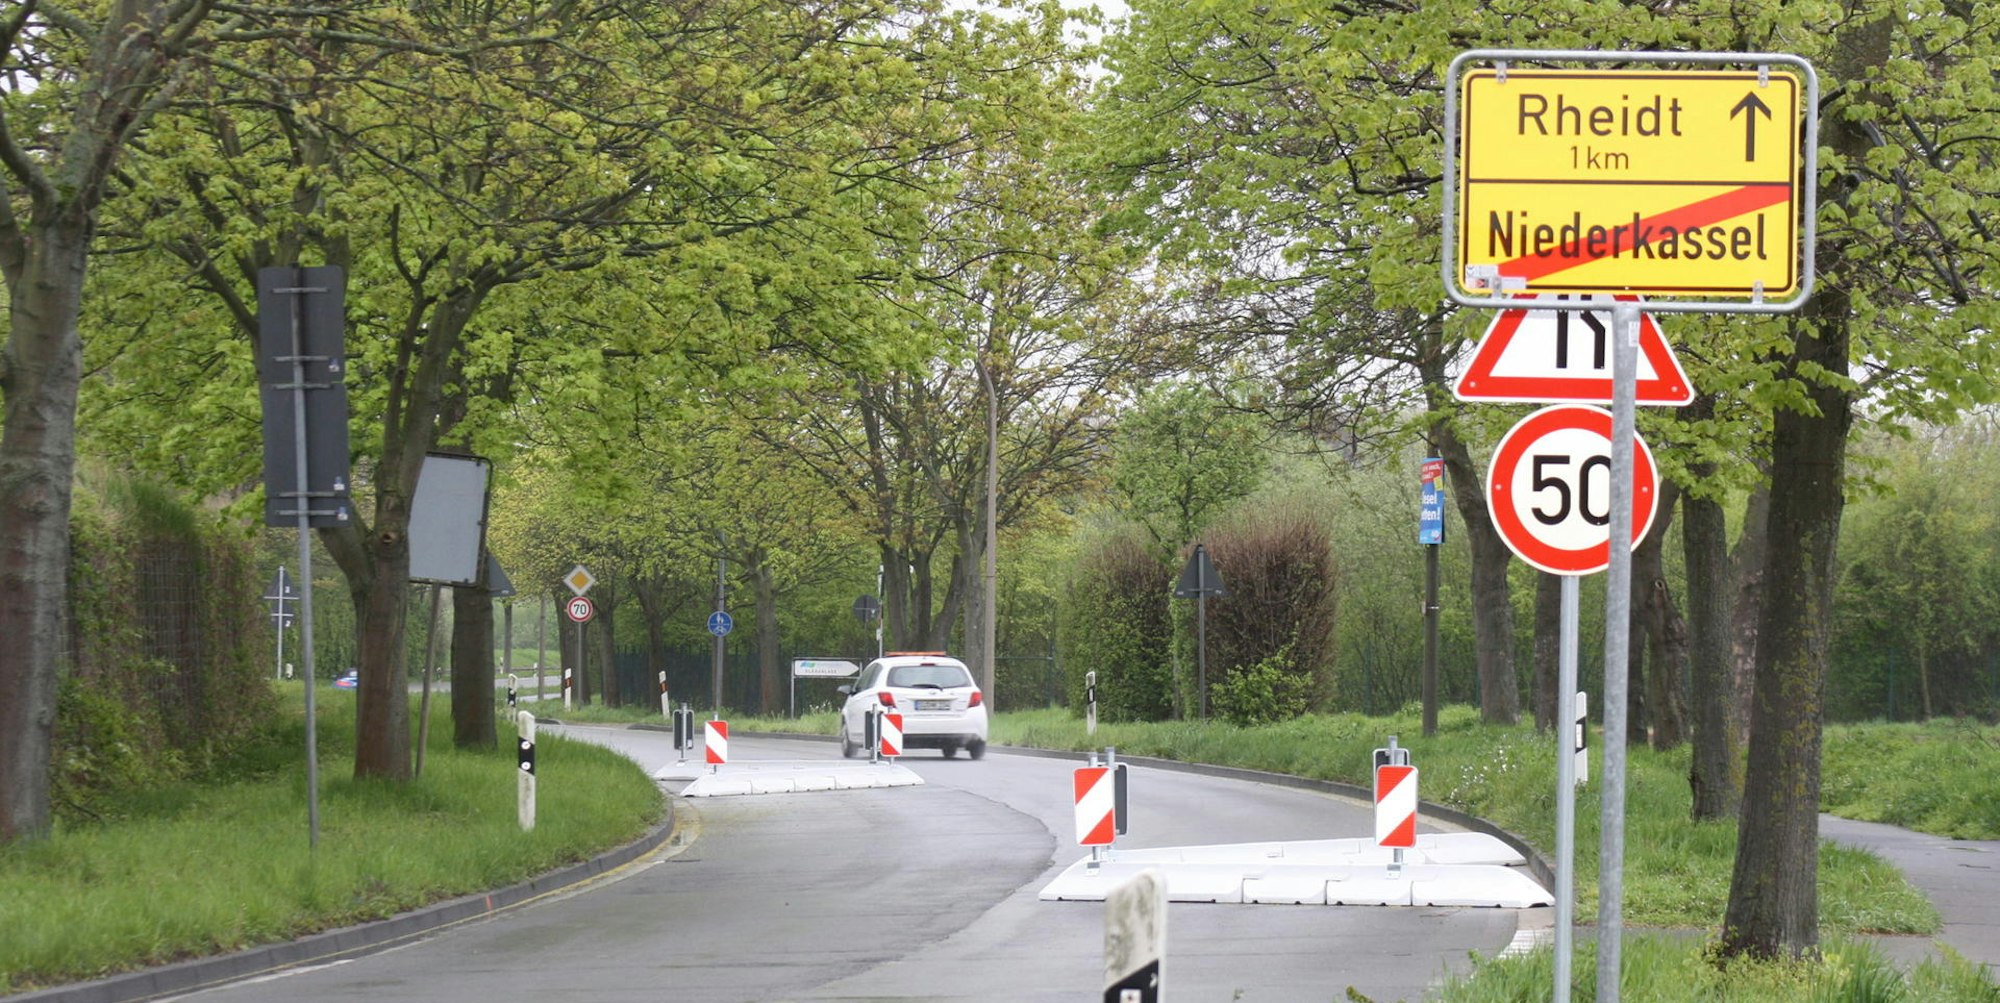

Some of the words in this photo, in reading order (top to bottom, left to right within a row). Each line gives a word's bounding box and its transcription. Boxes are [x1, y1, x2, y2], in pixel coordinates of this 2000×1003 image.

[1518, 94, 1682, 136] Rheidt
[1489, 211, 1767, 260] Niederkassel
[1532, 455, 1611, 526] 50
[574, 604, 587, 615] 70
